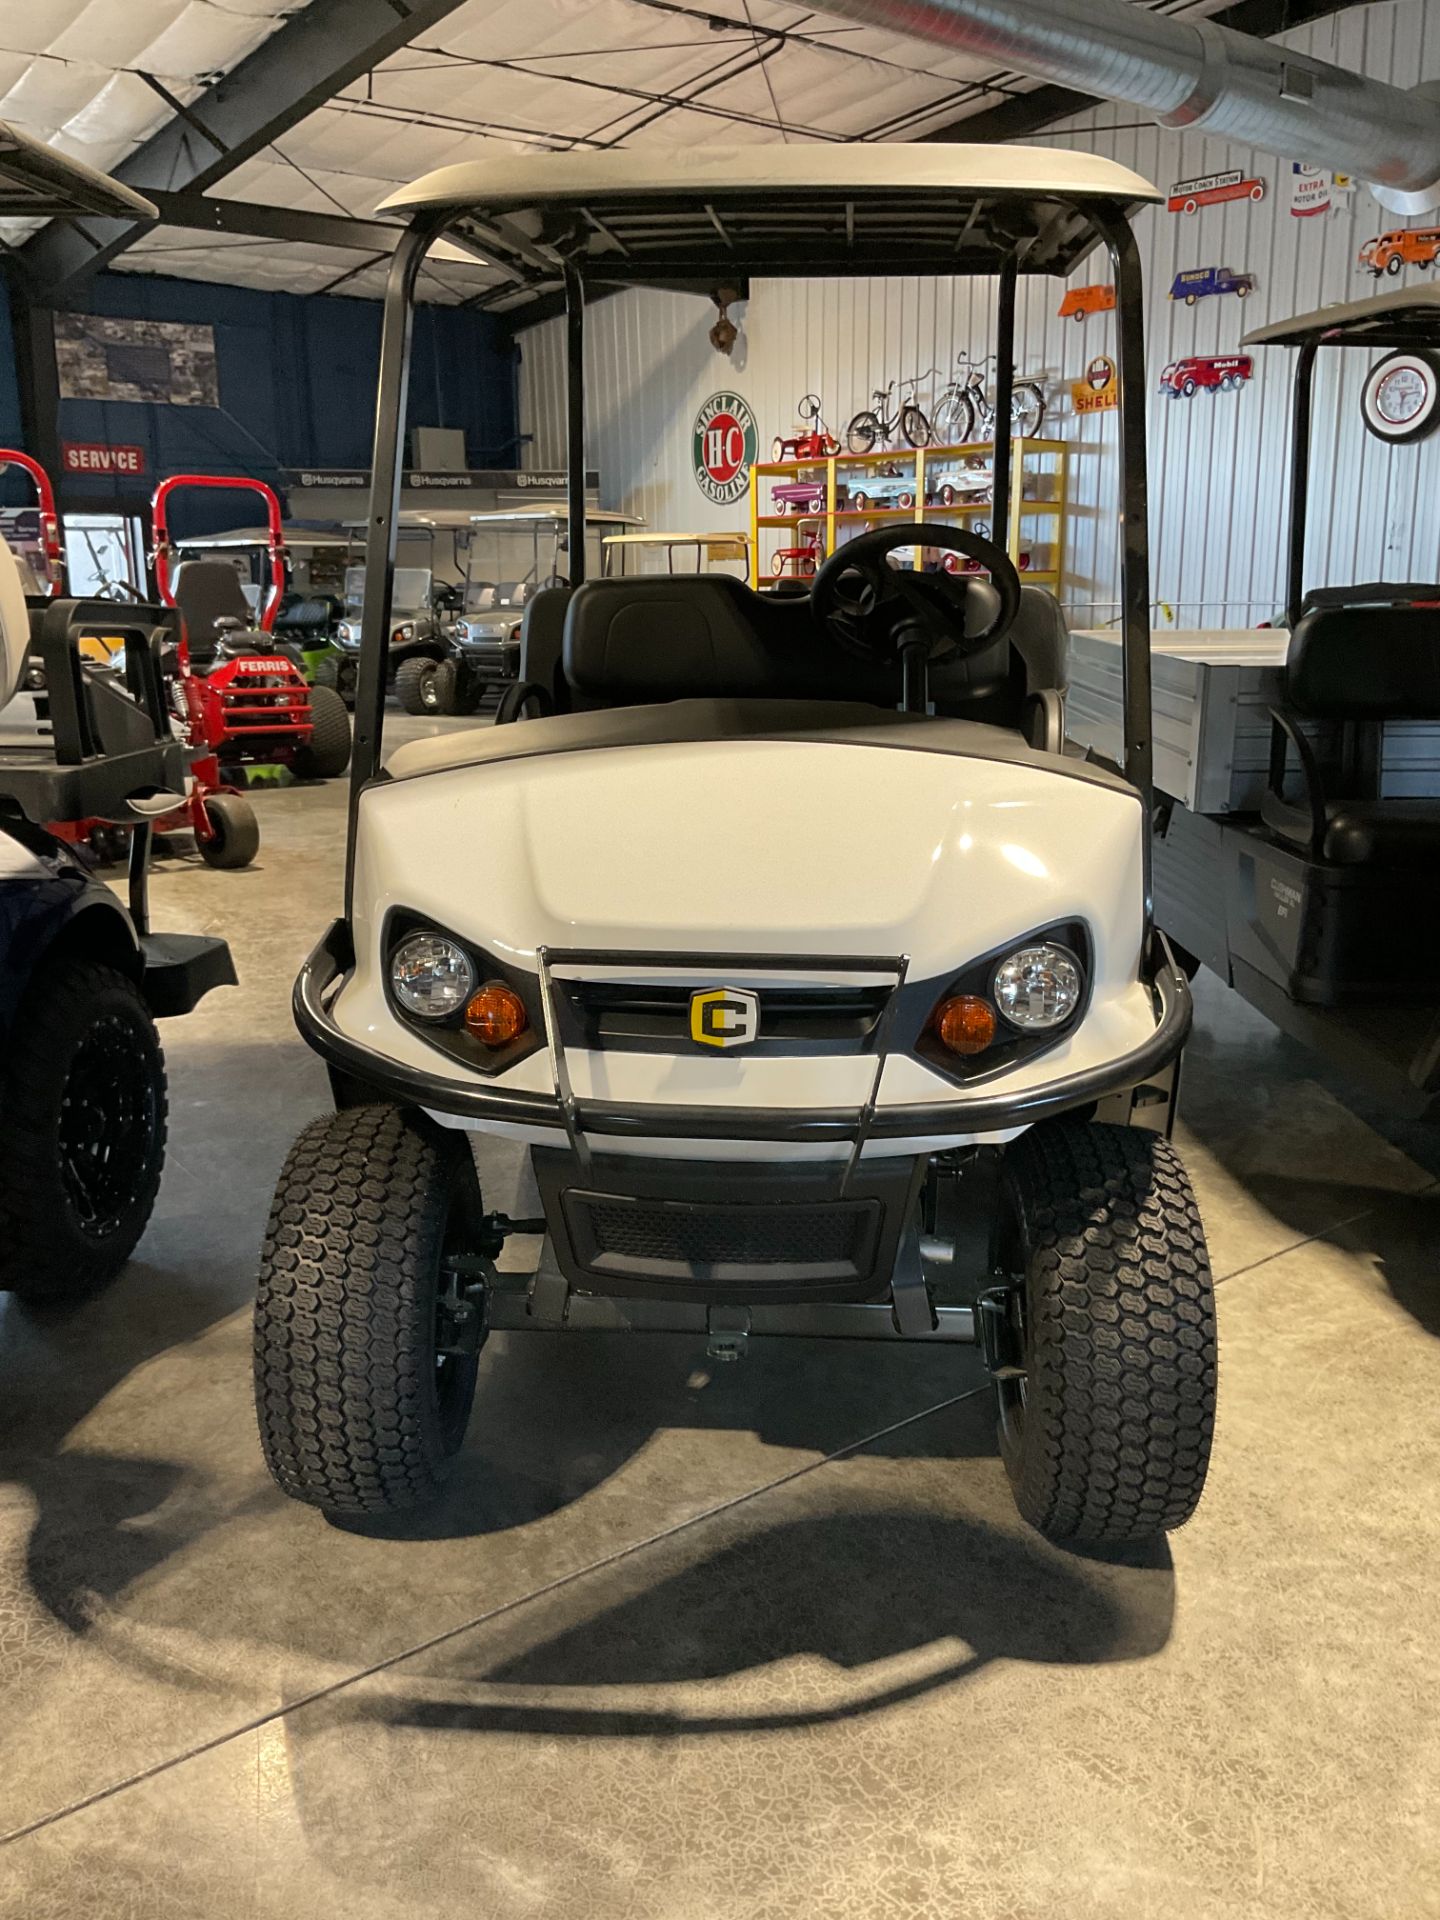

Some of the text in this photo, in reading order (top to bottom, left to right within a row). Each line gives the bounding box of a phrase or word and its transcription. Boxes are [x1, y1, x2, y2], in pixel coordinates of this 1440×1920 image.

[1173, 174, 1239, 195] MOTOR COACH STATION
[1298, 179, 1324, 193] EXTRA
[1181, 271, 1209, 282] SUNOCO
[1213, 360, 1239, 369] Mobil
[1076, 394, 1118, 410] SHELL
[696, 397, 751, 437] SINCLAIR
[68, 449, 138, 470] SERVICE
[313, 475, 364, 486] Husqvarna
[421, 475, 472, 486] Husqvarna
[528, 476, 569, 486] Husqvar
[697, 463, 750, 500] GASOLINE
[239, 661, 290, 672] FERRIS
